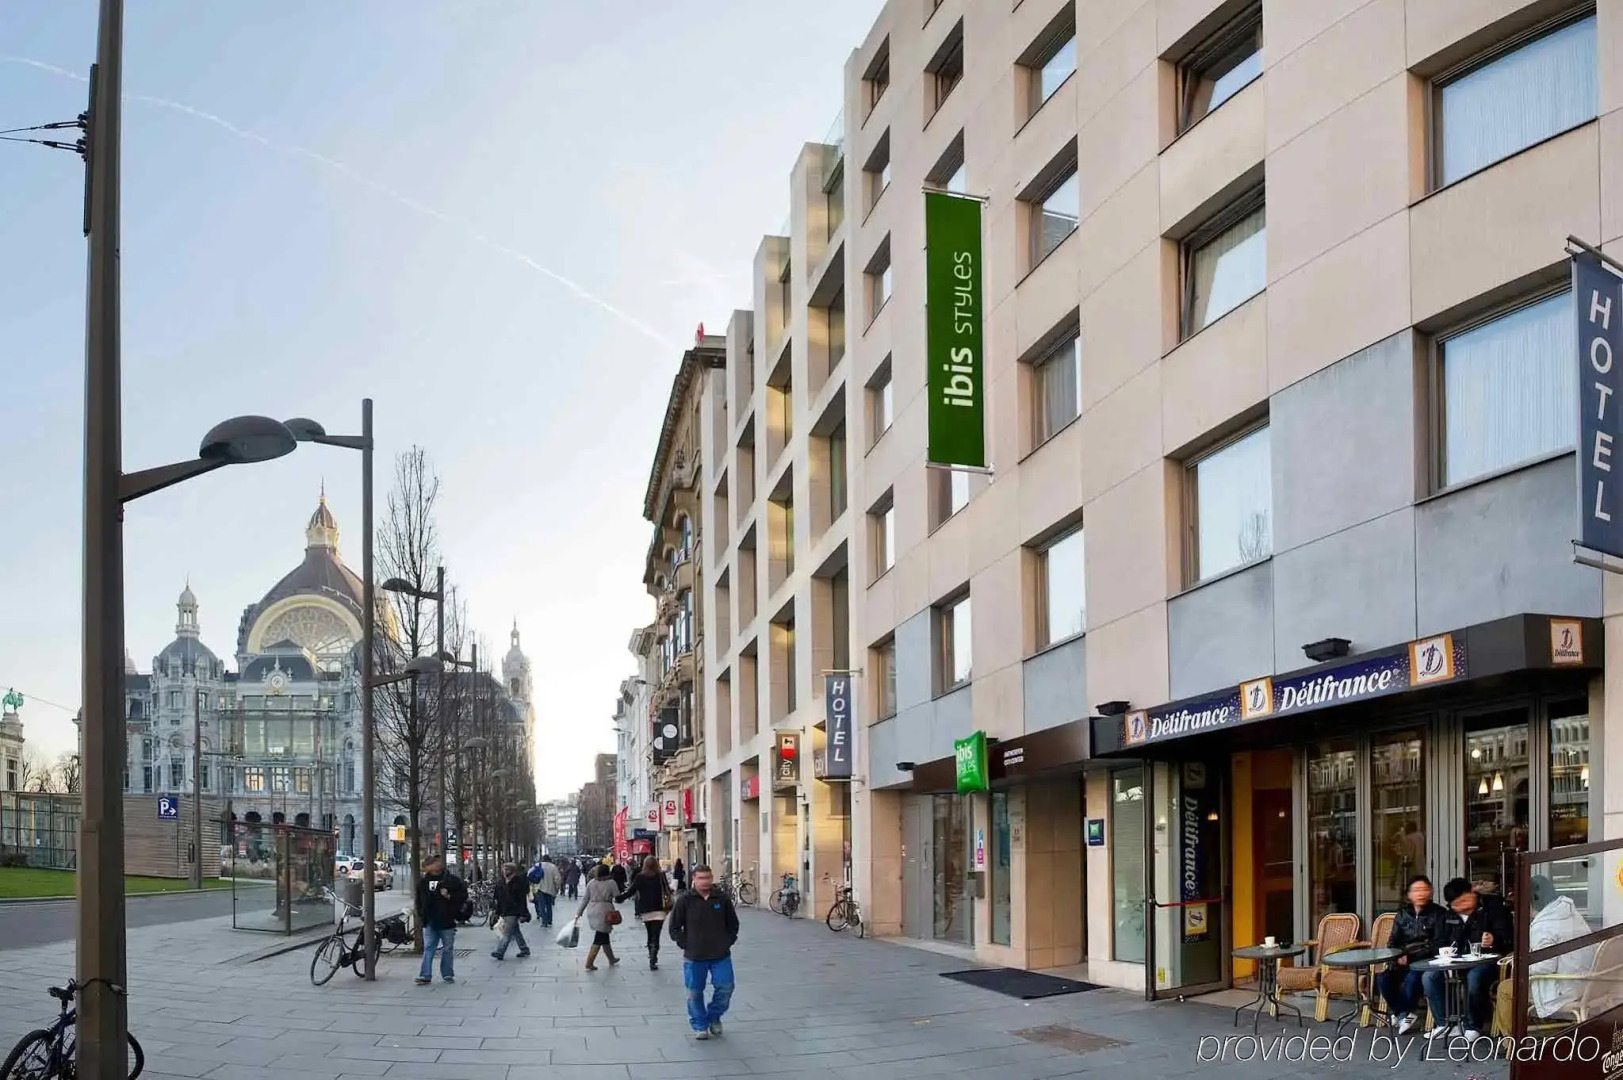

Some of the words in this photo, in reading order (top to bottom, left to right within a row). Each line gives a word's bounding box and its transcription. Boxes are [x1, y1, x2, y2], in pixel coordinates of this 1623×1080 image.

[943, 347, 973, 407] ibis
[1589, 289, 1613, 522] HOTEL
[1278, 669, 1392, 713] Délifrance
[832, 681, 846, 762] HOTEL
[1150, 705, 1229, 739] Délifrance
[781, 759, 792, 776] city
[160, 801, 170, 815] P
